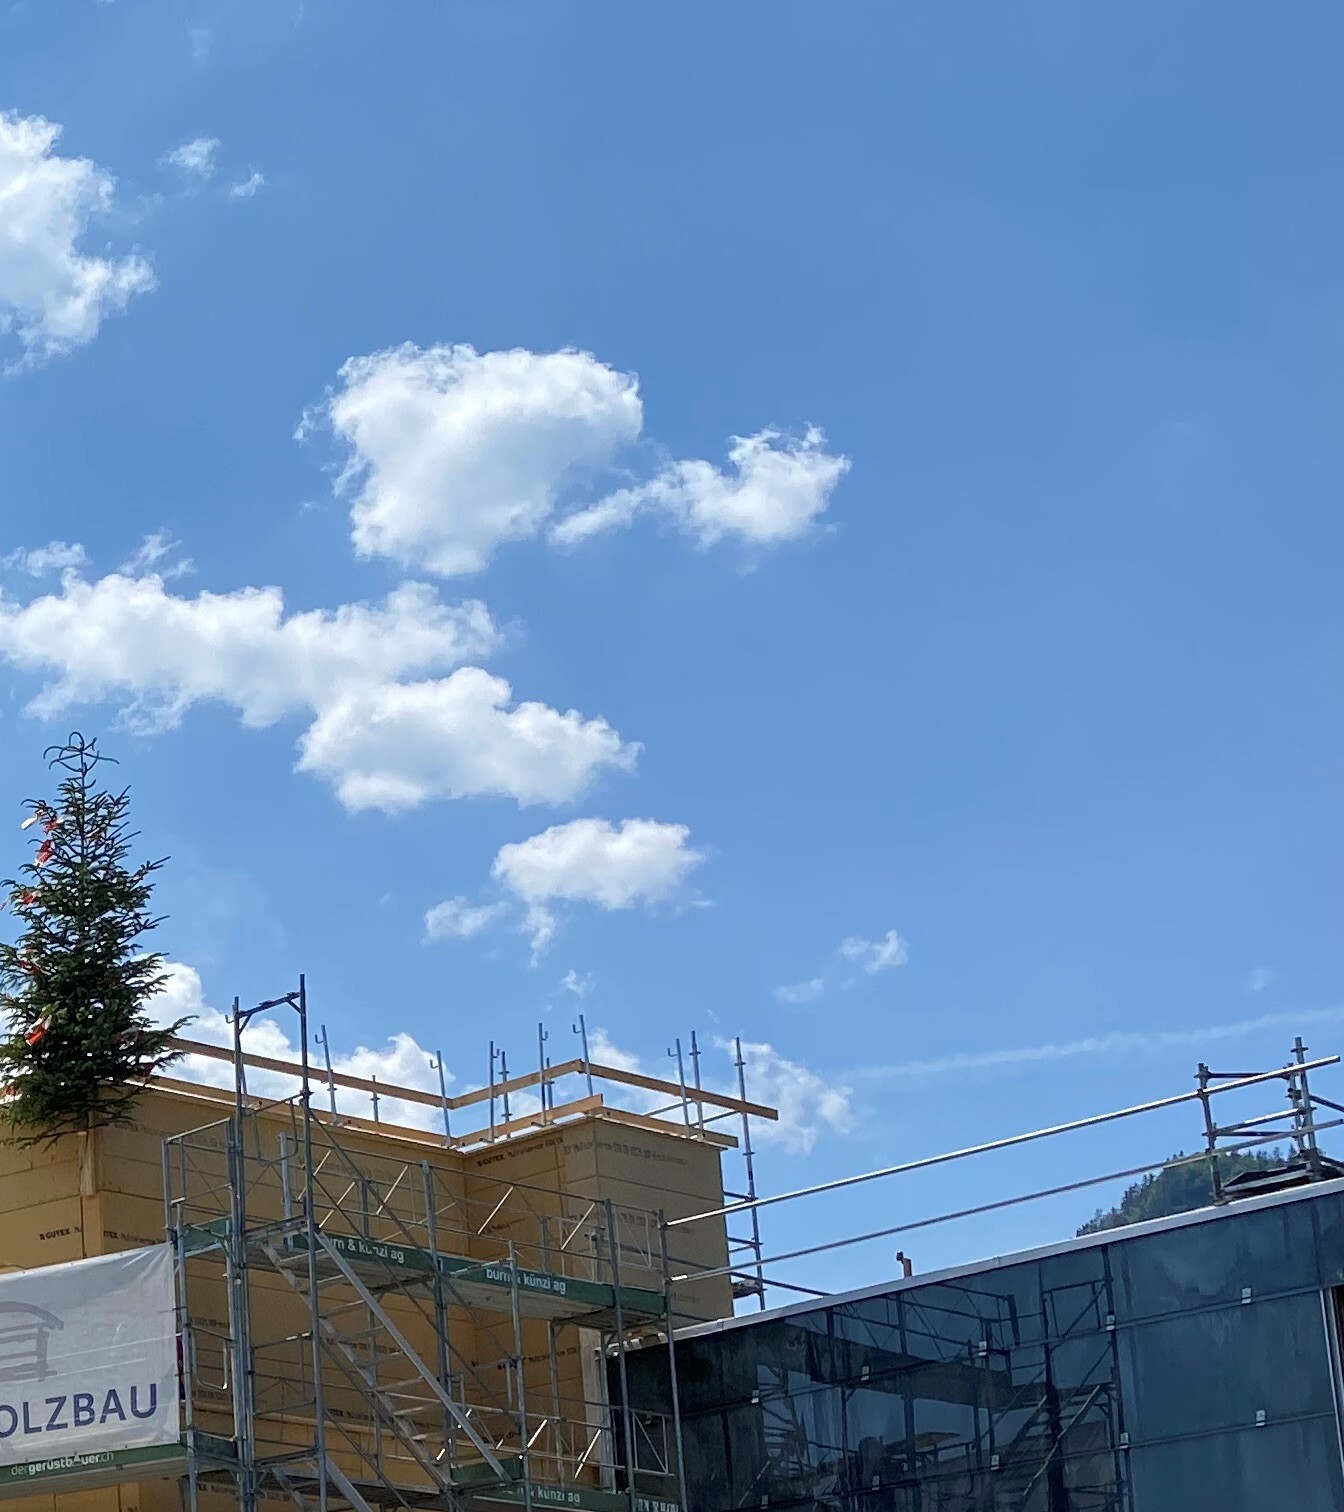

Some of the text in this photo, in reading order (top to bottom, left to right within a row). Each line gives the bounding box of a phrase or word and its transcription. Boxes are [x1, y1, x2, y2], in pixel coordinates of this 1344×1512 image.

[46, 1227, 70, 1239] GUTEX
[348, 1239, 356, 1251] &
[391, 1251, 404, 1264] ag
[553, 1279, 566, 1294] ag
[568, 1491, 581, 1506] ag
